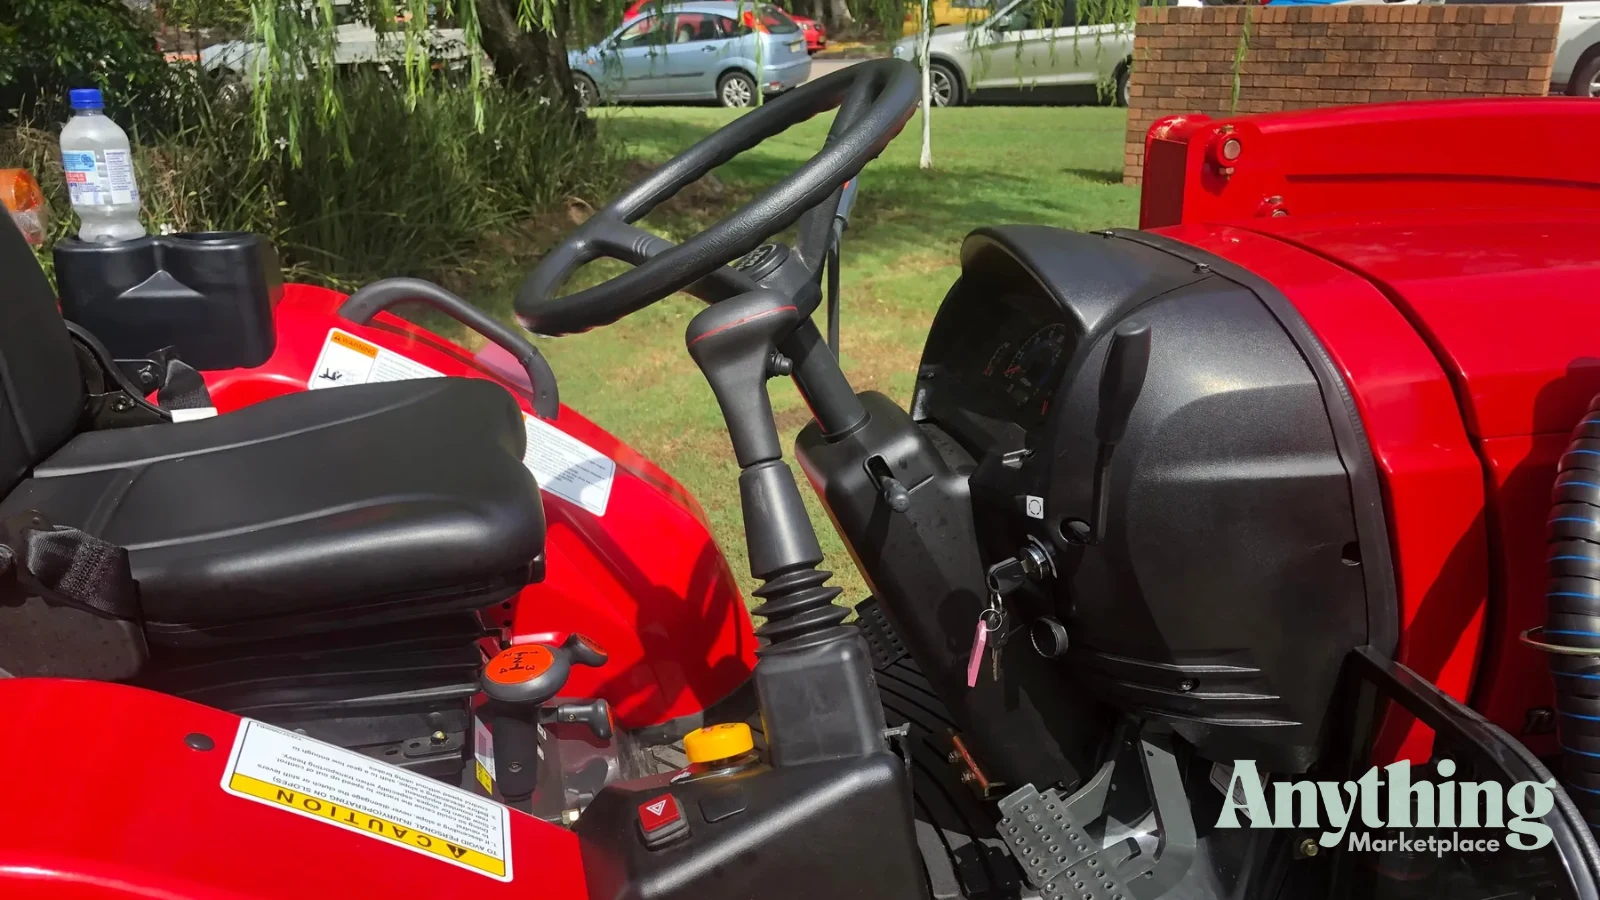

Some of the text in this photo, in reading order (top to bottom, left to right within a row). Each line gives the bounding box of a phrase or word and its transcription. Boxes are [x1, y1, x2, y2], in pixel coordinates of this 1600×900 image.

[301, 747, 330, 761] enough
[331, 758, 344, 766] low
[345, 762, 362, 772] gear
[256, 763, 280, 774] levers
[307, 760, 353, 780] transporting
[282, 771, 300, 780] shift
[378, 774, 395, 784] shift
[394, 774, 413, 784] using
[271, 776, 311, 793] SLOPES)
[312, 780, 335, 792] clutch
[341, 778, 364, 790] speed
[355, 777, 375, 788] when
[415, 782, 441, 794] without
[313, 789, 326, 797] ON
[375, 790, 399, 801] tractor
[377, 784, 412, 801] especially
[442, 791, 462, 802] speed
[351, 792, 389, 810] disengage
[400, 798, 412, 806] the
[413, 797, 439, 810] slopes,
[425, 790, 465, 809] descending
[464, 799, 488, 811] control
[391, 806, 411, 817] never
[414, 803, 435, 813] cause
[441, 807, 450, 815] for
[443, 802, 473, 816] mounted
[466, 805, 488, 817] Before
[275, 788, 431, 848] CAUTION
[413, 813, 434, 825] slope,
[436, 811, 456, 821] could
[452, 811, 470, 822] down
[475, 814, 488, 822] rear
[468, 822, 488, 833] Doing
[472, 818, 488, 828] Slow
[414, 822, 458, 841] PERSONAL
[442, 823, 483, 842] descending
[460, 838, 484, 851] AVOID
[486, 847, 496, 855] TO
